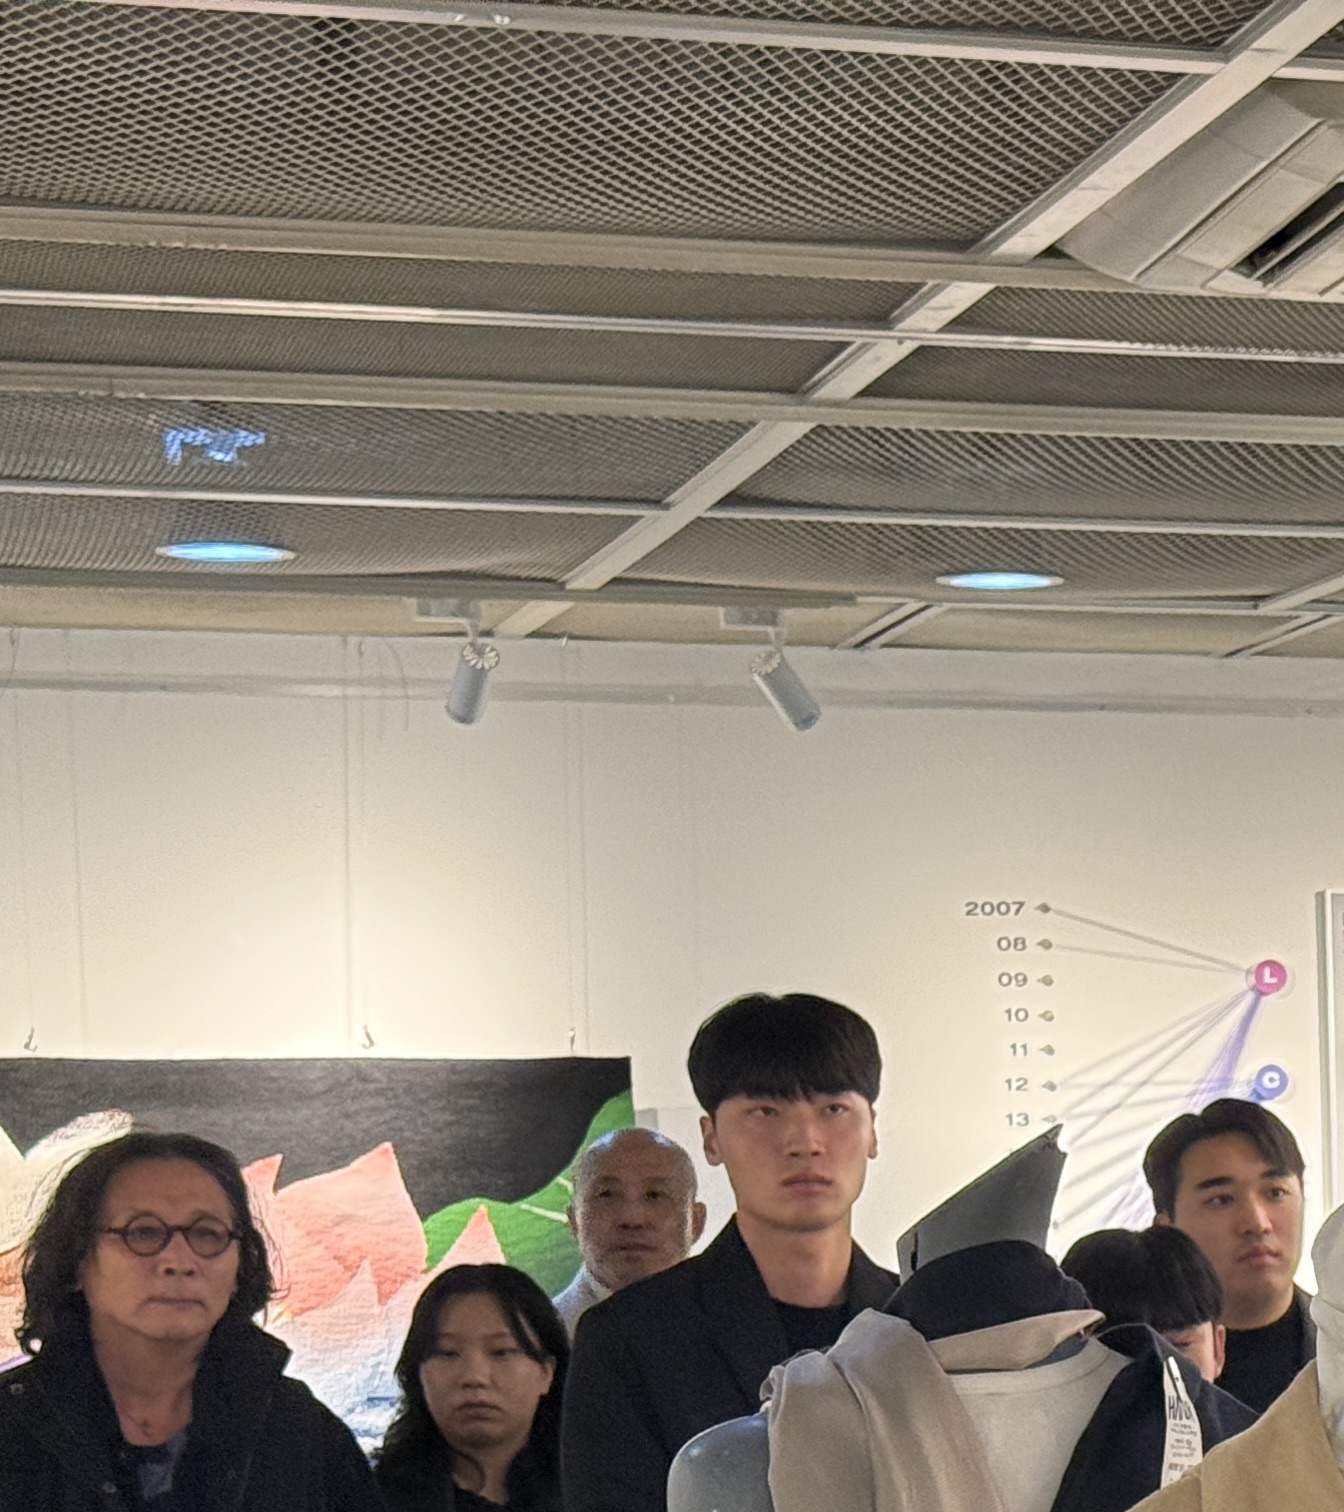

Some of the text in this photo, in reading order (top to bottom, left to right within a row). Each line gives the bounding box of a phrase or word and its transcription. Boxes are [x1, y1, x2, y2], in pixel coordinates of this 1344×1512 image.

[964, 901, 1026, 917] 2007
[996, 936, 1028, 952] 08
[997, 972, 1029, 988] 09
[1263, 966, 1279, 984] L
[1004, 1007, 1030, 1023] 10
[1009, 1043, 1029, 1057] 11
[1004, 1077, 1030, 1092] 12
[1261, 1071, 1281, 1090] C
[1005, 1112, 1030, 1127] 13
